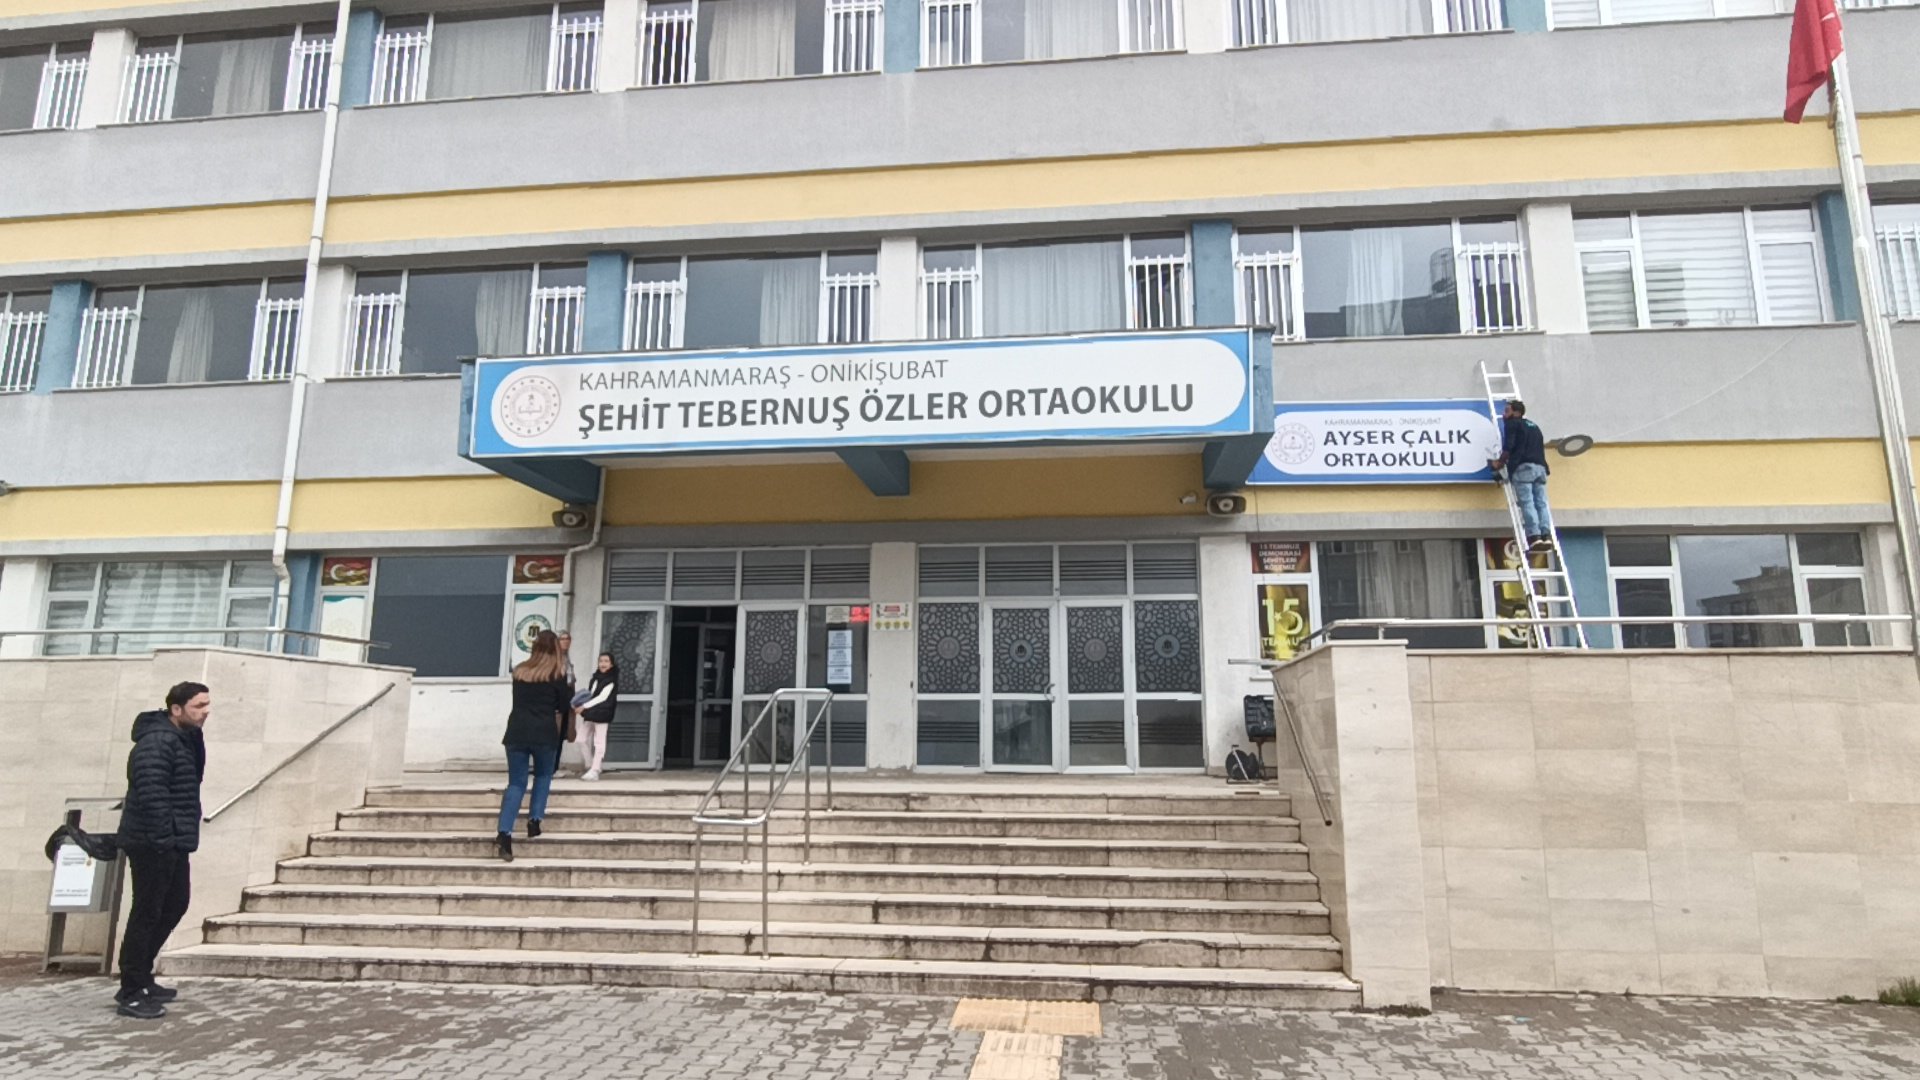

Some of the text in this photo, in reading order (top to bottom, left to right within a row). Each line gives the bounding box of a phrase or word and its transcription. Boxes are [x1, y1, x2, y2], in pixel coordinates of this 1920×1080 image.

[579, 365, 791, 391] KAHRAMANMARAŞ
[811, 359, 949, 386] ONİKİŞUBAT
[578, 383, 1194, 440] ŞEHİT TEBERNUŞ ÖZLER ORTAOKULU
[1401, 429, 1471, 448] ÇALIK
[1324, 451, 1455, 467] ORTAOKULU
[1262, 598, 1303, 636] 15
